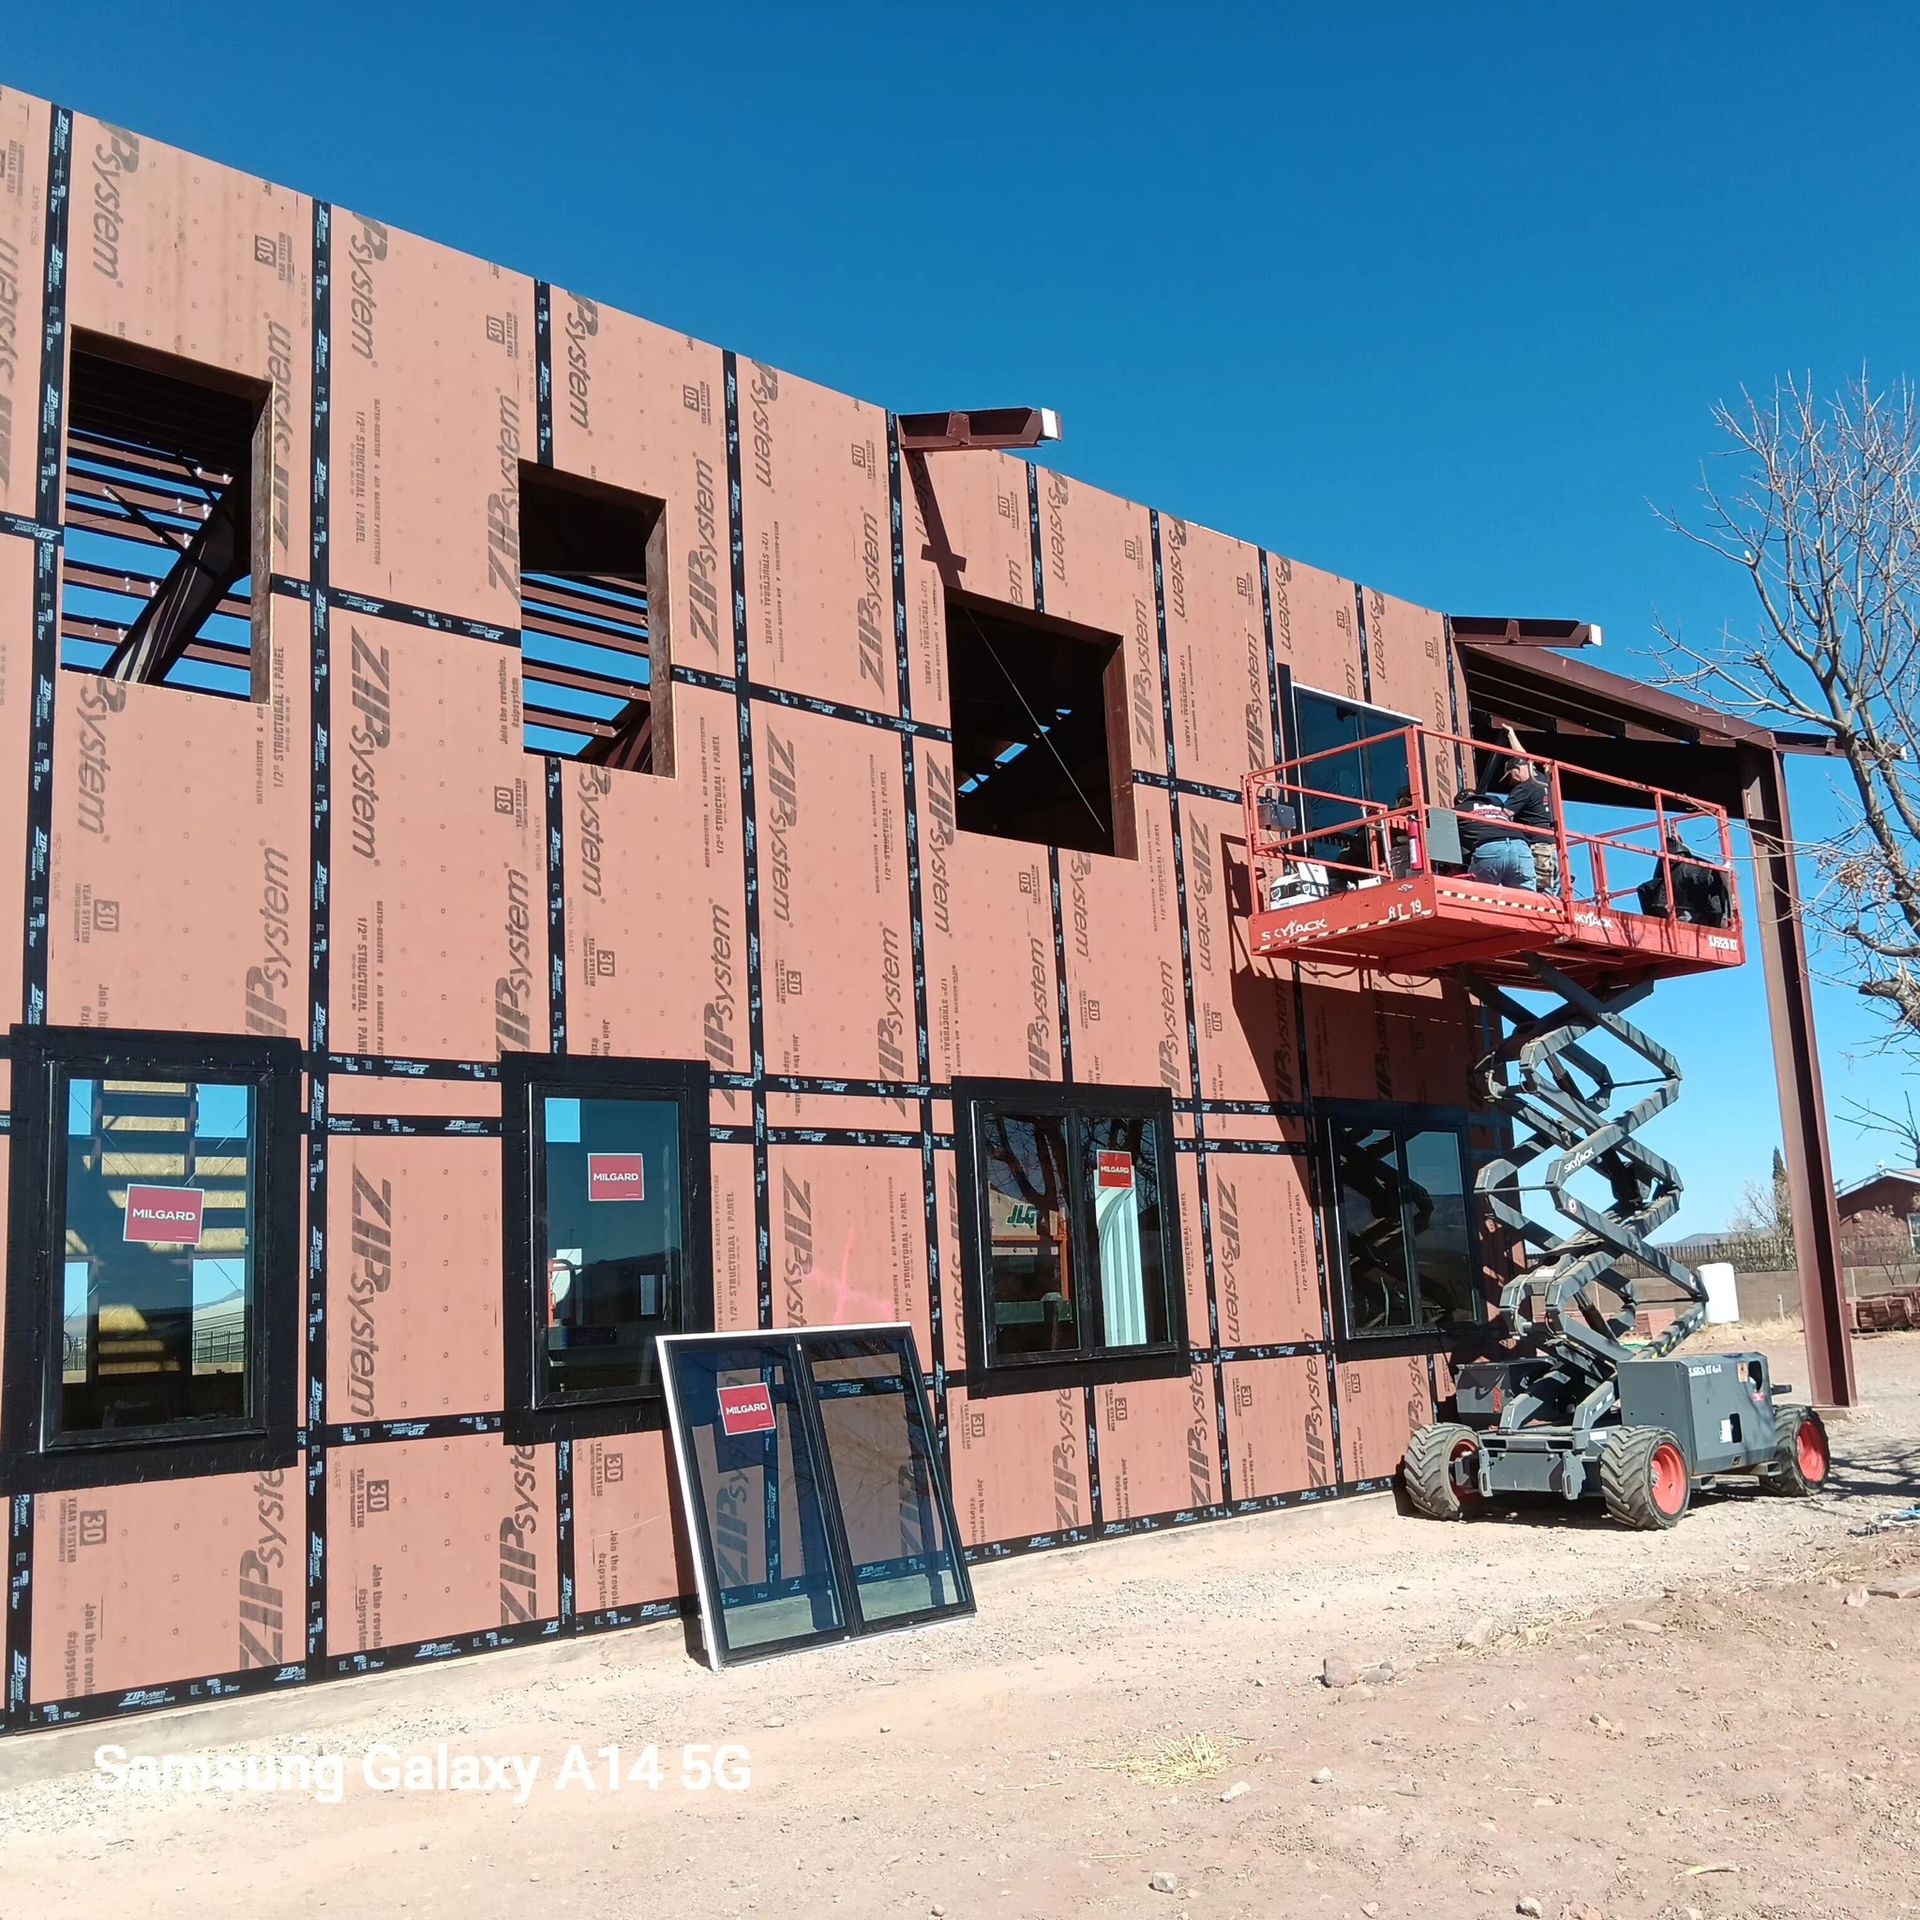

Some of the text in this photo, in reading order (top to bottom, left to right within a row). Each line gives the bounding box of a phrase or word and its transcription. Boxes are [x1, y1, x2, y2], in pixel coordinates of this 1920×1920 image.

[1410, 899, 1422, 914] 19
[1100, 1166, 1130, 1174] MILGARD
[1564, 1147, 1594, 1174] SKYJACK
[593, 1172, 639, 1182] MILGARD
[132, 1208, 196, 1222] MILGARD
[1007, 1203, 1038, 1226] JLG
[725, 1402, 768, 1416] MILGARD
[606, 1454, 622, 1481] 30
[368, 1481, 388, 1511] 30
[82, 1512, 104, 1544] 30
